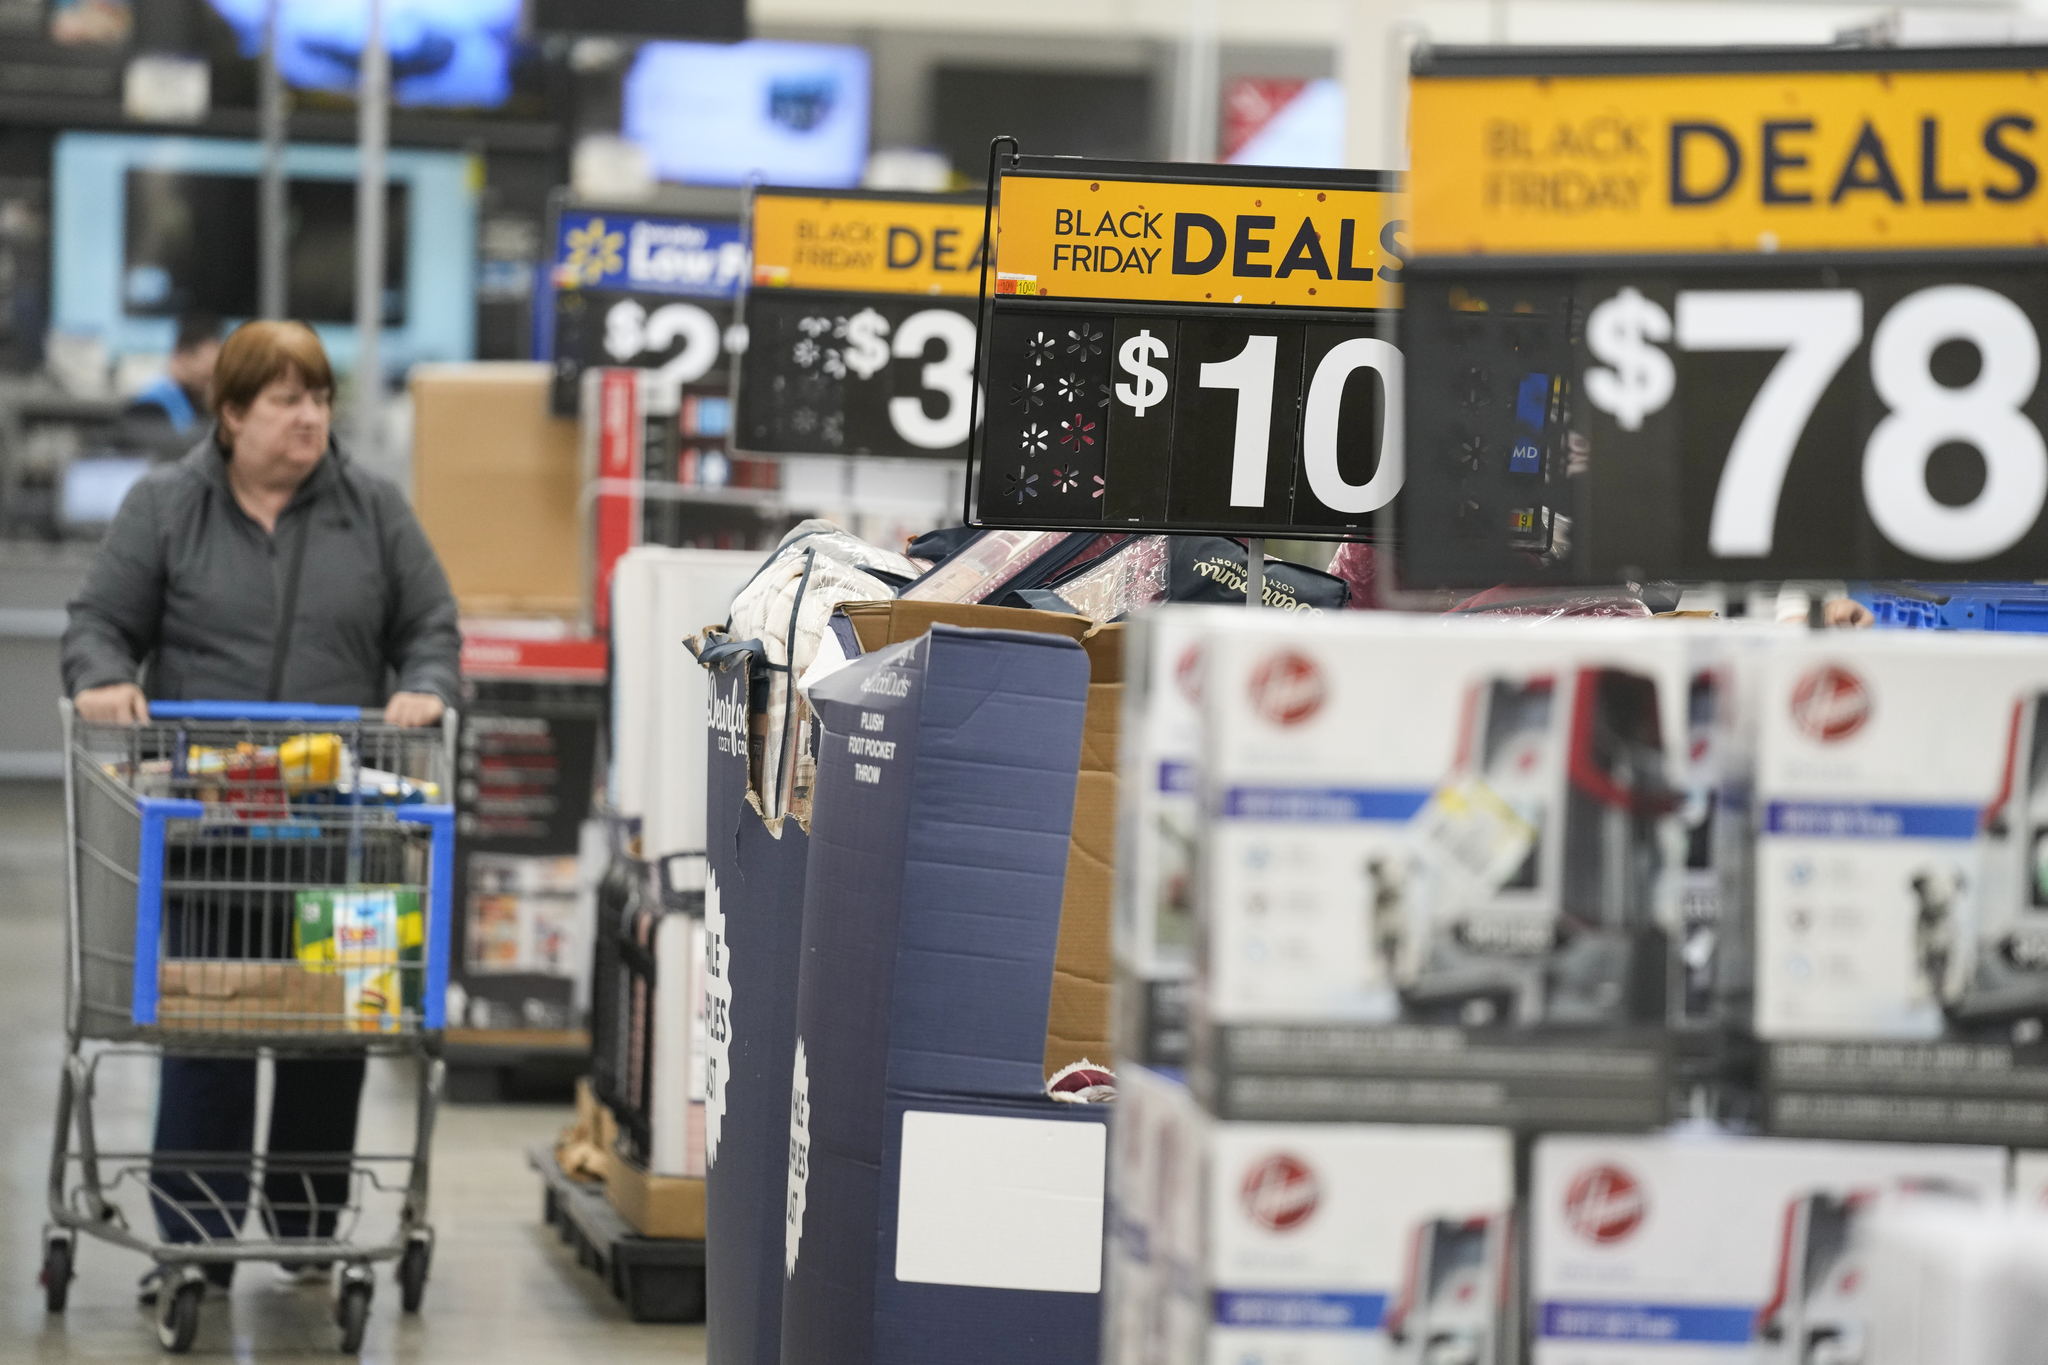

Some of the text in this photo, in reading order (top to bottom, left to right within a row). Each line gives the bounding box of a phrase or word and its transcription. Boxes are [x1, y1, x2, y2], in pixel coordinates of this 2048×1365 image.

[1485, 113, 1652, 163] BLACK
[1666, 112, 2042, 207] DEALS
[1485, 168, 1650, 216] FRIDAY
[796, 218, 879, 244] BLACK
[1055, 208, 1164, 240] BLACK
[1052, 243, 1163, 275] FRIDAY
[844, 306, 984, 449] $3
[1115, 329, 1407, 514] $10
[1584, 284, 2048, 562] $78
[1210, 556, 1295, 594] COZY OMFORT
[861, 711, 885, 732] PLUSH
[718, 735, 730, 753] COZY
[848, 735, 896, 760] FOOT POCKET
[855, 763, 881, 784] THROW
[705, 989, 726, 1043] PLIES
